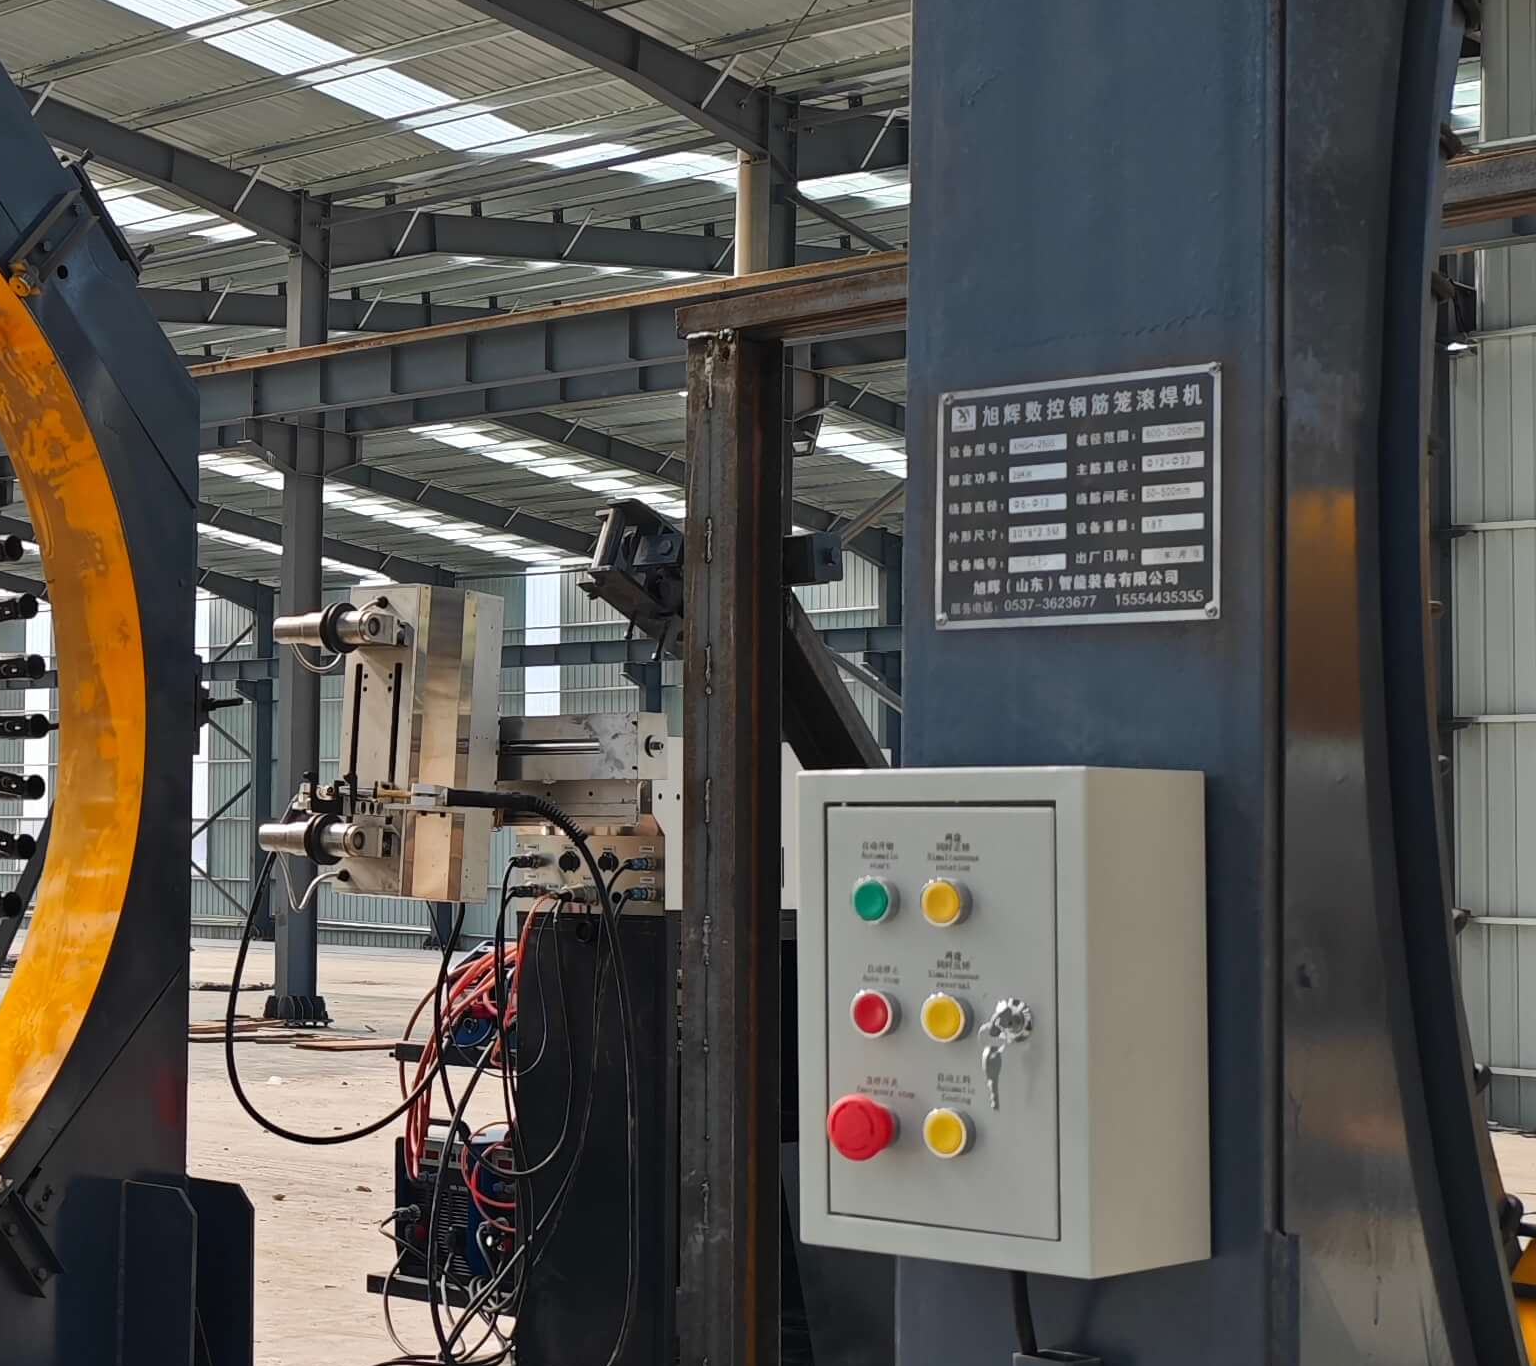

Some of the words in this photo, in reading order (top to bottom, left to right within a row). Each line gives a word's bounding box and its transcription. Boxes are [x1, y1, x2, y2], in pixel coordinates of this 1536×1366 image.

[982, 384, 1202, 427] 旭辉数控钢筋笼滚焊机
[1004, 595, 1096, 611] 0537-3623677
[1115, 590, 1204, 606] 15554435355
